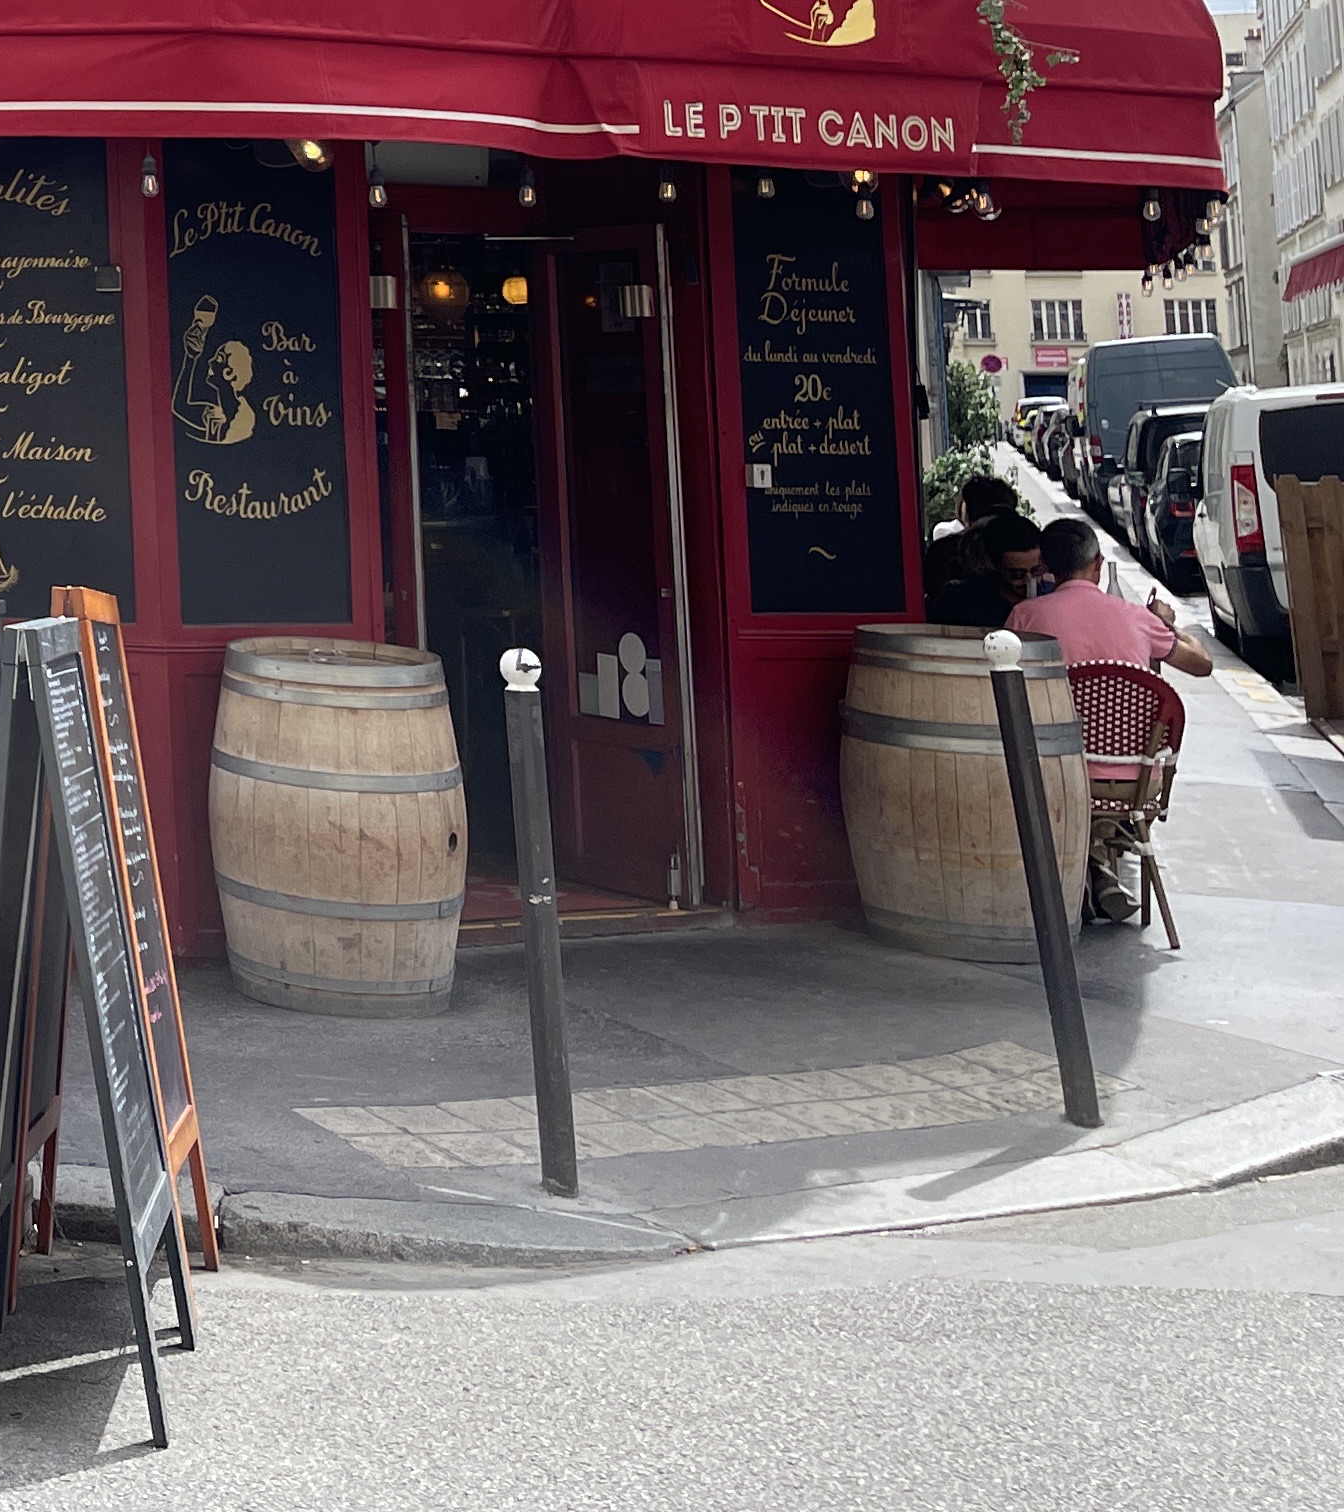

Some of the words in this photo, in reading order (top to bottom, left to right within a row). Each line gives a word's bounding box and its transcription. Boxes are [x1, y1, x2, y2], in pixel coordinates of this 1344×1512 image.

[662, 99, 706, 139] LE
[817, 109, 955, 154] CANON
[169, 208, 199, 259] Le
[248, 203, 323, 258] Canon
[765, 253, 850, 293] Formule
[6, 308, 24, 325] de
[25, 299, 115, 333] Bourgogne
[757, 291, 857, 335] Déjeuner
[261, 321, 317, 353] Bar
[743, 345, 762, 363] du
[764, 339, 799, 363] lundi
[802, 352, 819, 363] au
[822, 345, 878, 365] vendredi
[282, 358, 299, 384] à
[262, 394, 333, 429] Vins
[762, 409, 810, 430] entrée
[825, 404, 861, 440] plat
[2, 430, 97, 463] Maison
[771, 431, 804, 468] plat
[819, 434, 872, 456] dessert
[2, 489, 107, 522] l'échalote
[184, 468, 333, 520] Restaurant
